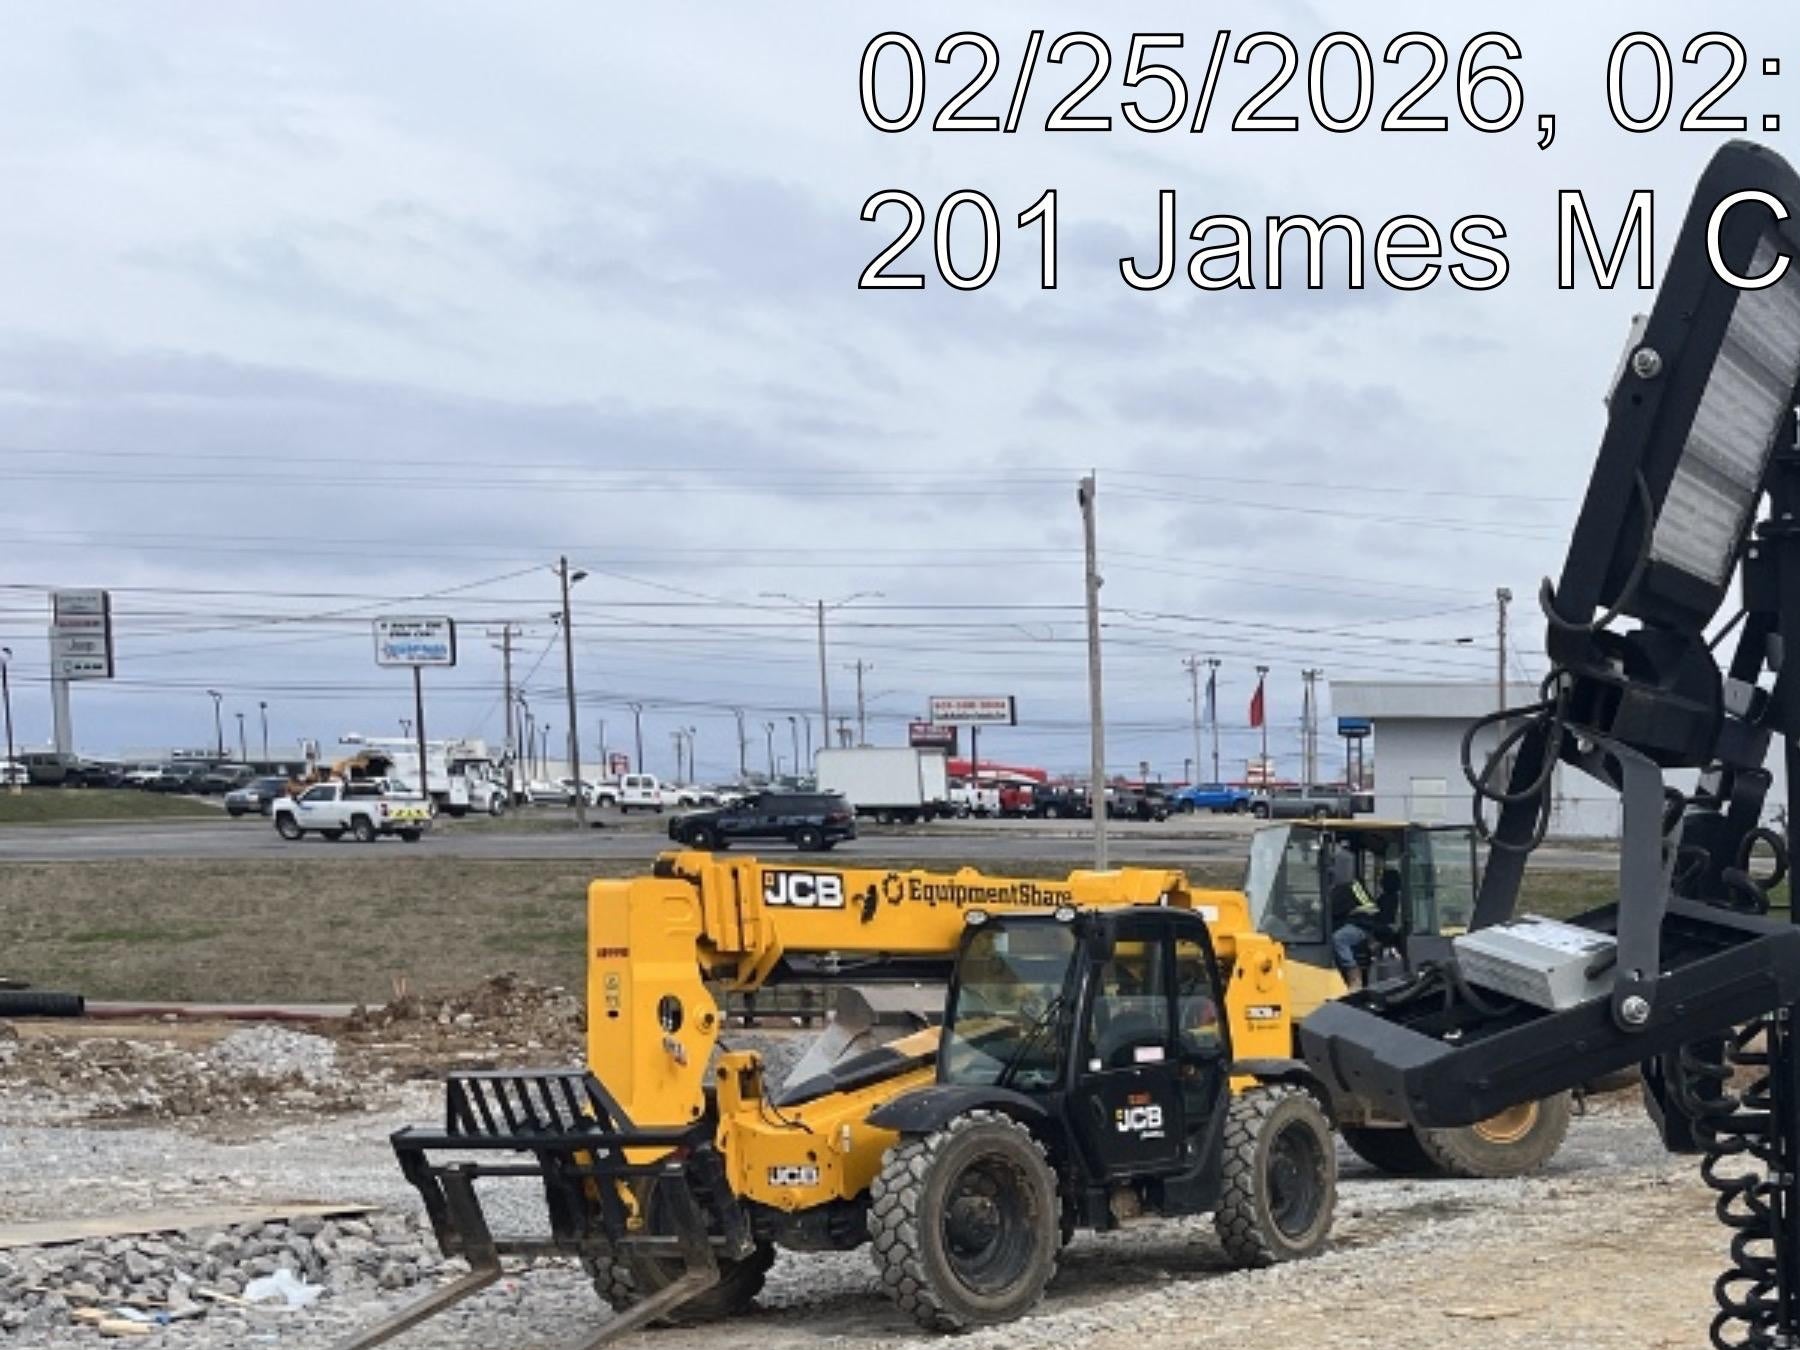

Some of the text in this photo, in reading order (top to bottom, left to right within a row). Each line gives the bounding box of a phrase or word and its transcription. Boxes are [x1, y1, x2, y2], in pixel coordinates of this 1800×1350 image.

[764, 872, 1073, 909] JCB EquipmentShare
[1115, 1106, 1162, 1132] JCB
[767, 1166, 819, 1185] JCB
